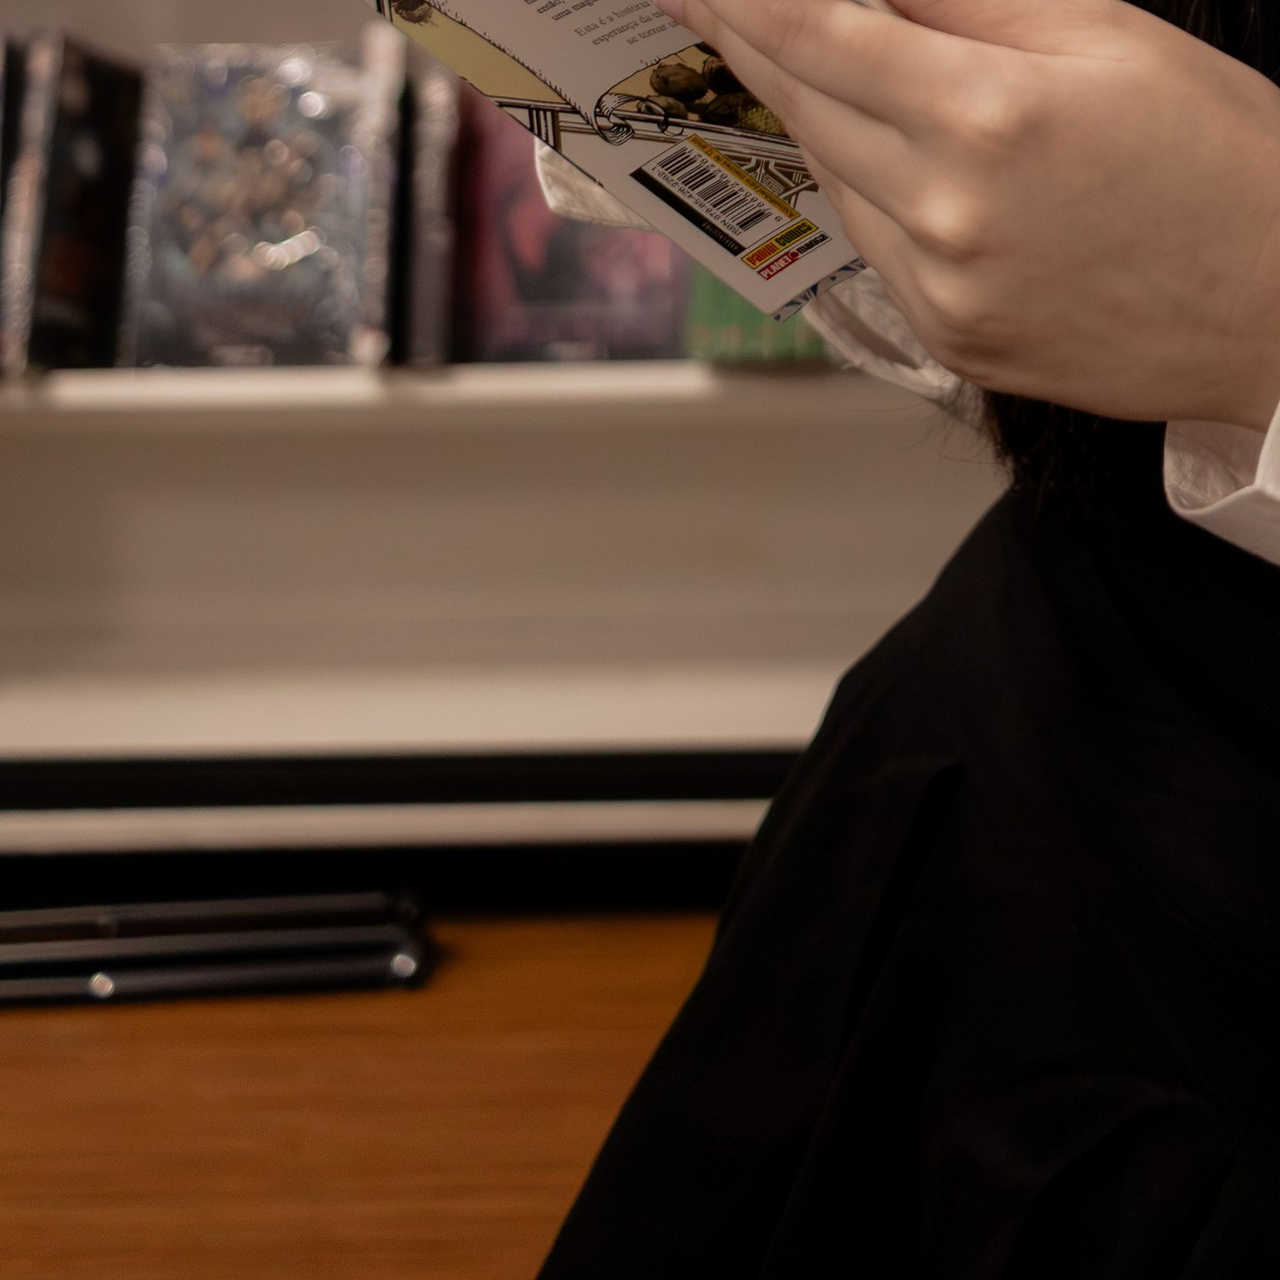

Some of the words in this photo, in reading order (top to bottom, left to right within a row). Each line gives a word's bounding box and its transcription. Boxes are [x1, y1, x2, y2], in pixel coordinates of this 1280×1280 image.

[537, 0, 566, 14] então,
[551, 8, 573, 21] uma
[574, 22, 600, 37] Esta
[598, 17, 607, 25] é
[611, 1, 651, 19] história
[592, 20, 640, 45] esperança
[627, 36, 639, 45] se
[637, 24, 668, 39] tornar
[721, 219, 742, 236] ISBN
[759, 255, 792, 279] PLANET
[796, 233, 829, 255] manga
